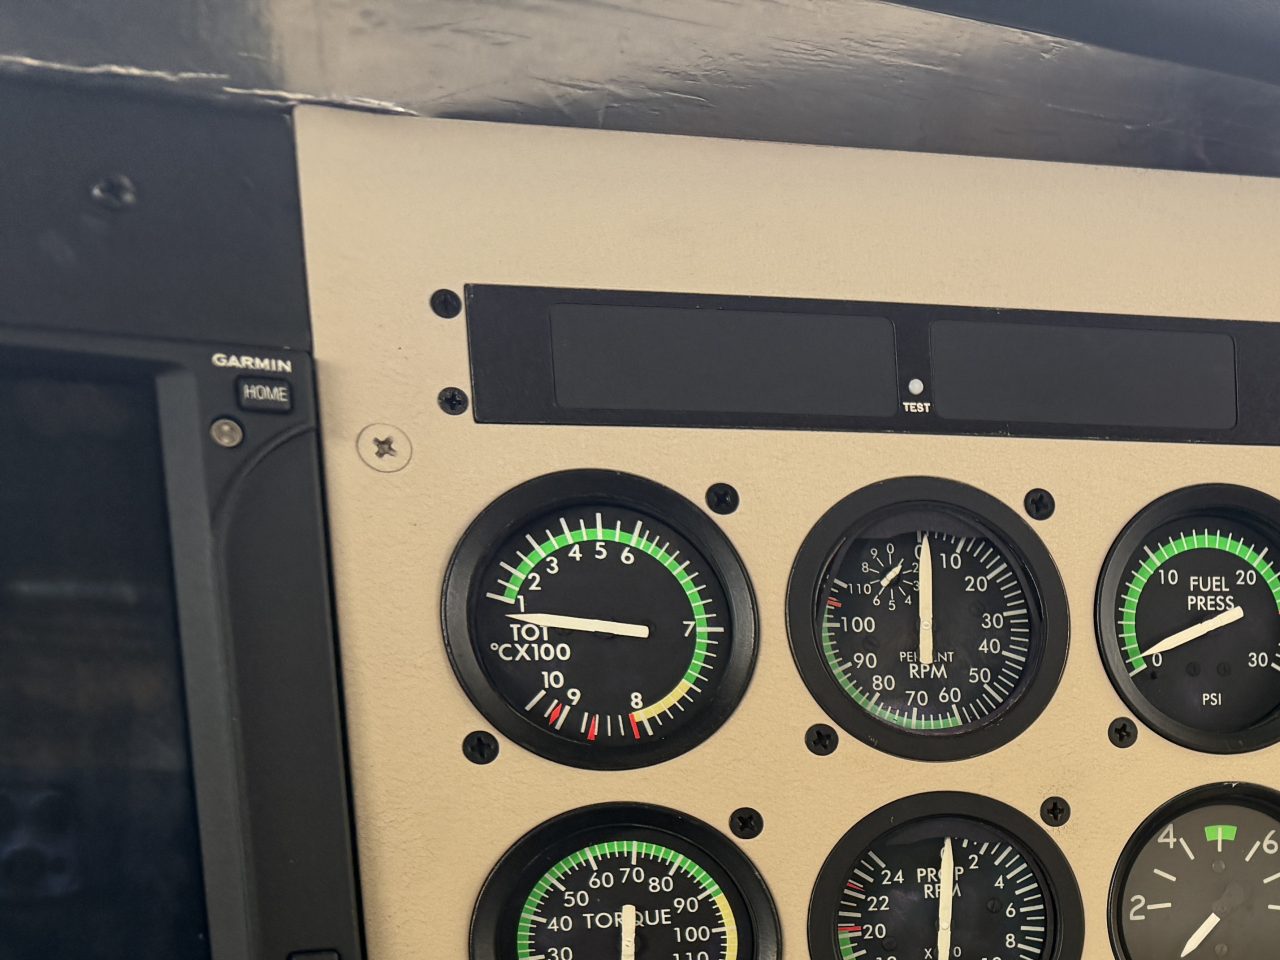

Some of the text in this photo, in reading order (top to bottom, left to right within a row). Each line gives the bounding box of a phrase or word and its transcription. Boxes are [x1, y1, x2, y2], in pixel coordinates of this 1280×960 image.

[211, 353, 292, 373] GARMIN
[243, 384, 288, 401] HOME
[903, 402, 930, 412] TEST
[568, 544, 582, 561] 4
[595, 542, 607, 560] 5
[621, 548, 635, 564] 6
[870, 548, 878, 559] 9
[886, 543, 894, 554] 0
[546, 557, 559, 574] 3
[861, 562, 870, 573] 8
[912, 562, 920, 573] 2
[940, 553, 962, 569] 10
[528, 572, 542, 590] 2
[965, 576, 988, 592] 20
[1159, 569, 1178, 585] 10
[1190, 576, 1229, 592] FUEL
[1236, 570, 1257, 585] 20
[849, 583, 871, 594] 110
[517, 595, 525, 612] 1
[873, 597, 881, 606] 6
[888, 601, 896, 611] 5
[904, 595, 912, 605] 4
[1188, 596, 1235, 611] PRESS
[682, 620, 696, 637] 7
[841, 617, 875, 632] 100
[982, 613, 1003, 629] 30
[510, 624, 549, 642] TOT
[978, 638, 1000, 654] 40
[854, 653, 877, 669] 90
[1152, 652, 1162, 667] 0
[1248, 652, 1268, 667] 30
[541, 671, 564, 688] 10
[909, 664, 947, 679] RPM
[969, 668, 991, 683] 50
[872, 675, 895, 691] 80
[567, 689, 581, 705] 9
[630, 692, 643, 709] 8
[905, 690, 928, 706] 70
[939, 687, 961, 703] 60
[1202, 693, 1222, 706] PSI
[1157, 823, 1177, 848] 4
[1262, 830, 1279, 854] 6
[969, 855, 979, 869] 2
[588, 872, 614, 888] 60
[620, 867, 644, 883] 70
[881, 870, 904, 884] 24
[994, 875, 1004, 889] 4
[648, 876, 674, 892] 80
[564, 890, 589, 908] 50
[674, 897, 698, 914] 90
[867, 896, 889, 911] 22
[1006, 904, 1016, 918] 6
[1129, 895, 1146, 920] 2
[548, 915, 572, 932] 40
[863, 924, 886, 939] 20
[674, 926, 710, 942] 100
[1005, 934, 1016, 948] 8
